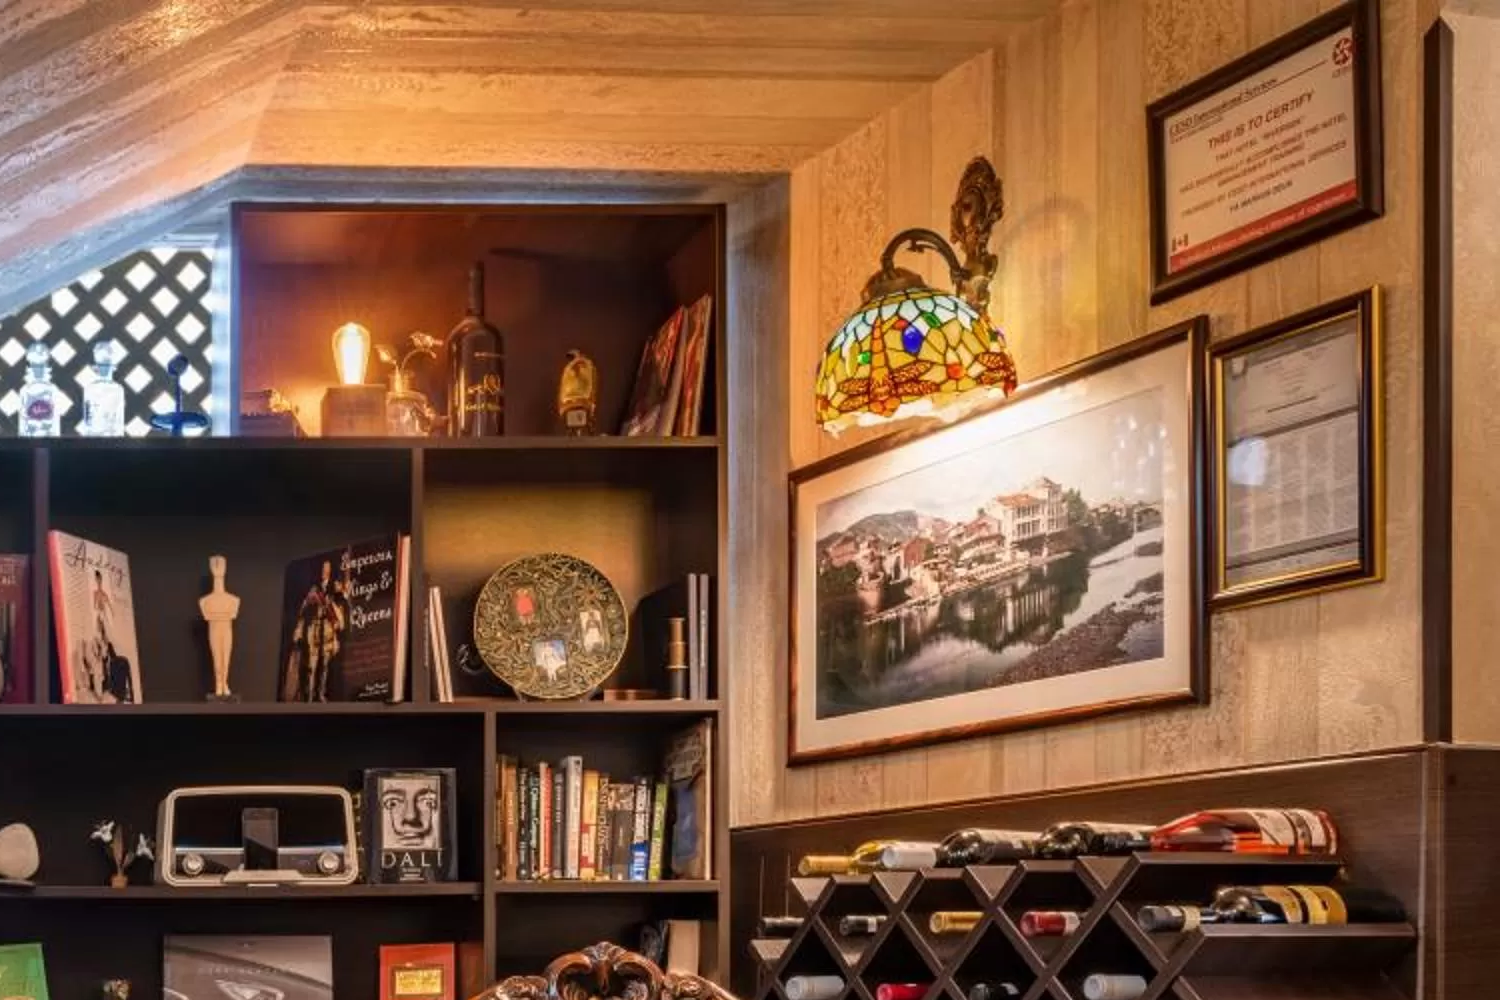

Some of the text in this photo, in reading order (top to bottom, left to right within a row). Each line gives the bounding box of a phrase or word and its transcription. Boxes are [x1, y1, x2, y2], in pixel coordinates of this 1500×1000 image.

[1208, 129, 1231, 149] THIS
[1233, 123, 1244, 138] IS
[1248, 113, 1263, 132] TO
[1265, 90, 1312, 123] CERTIFY
